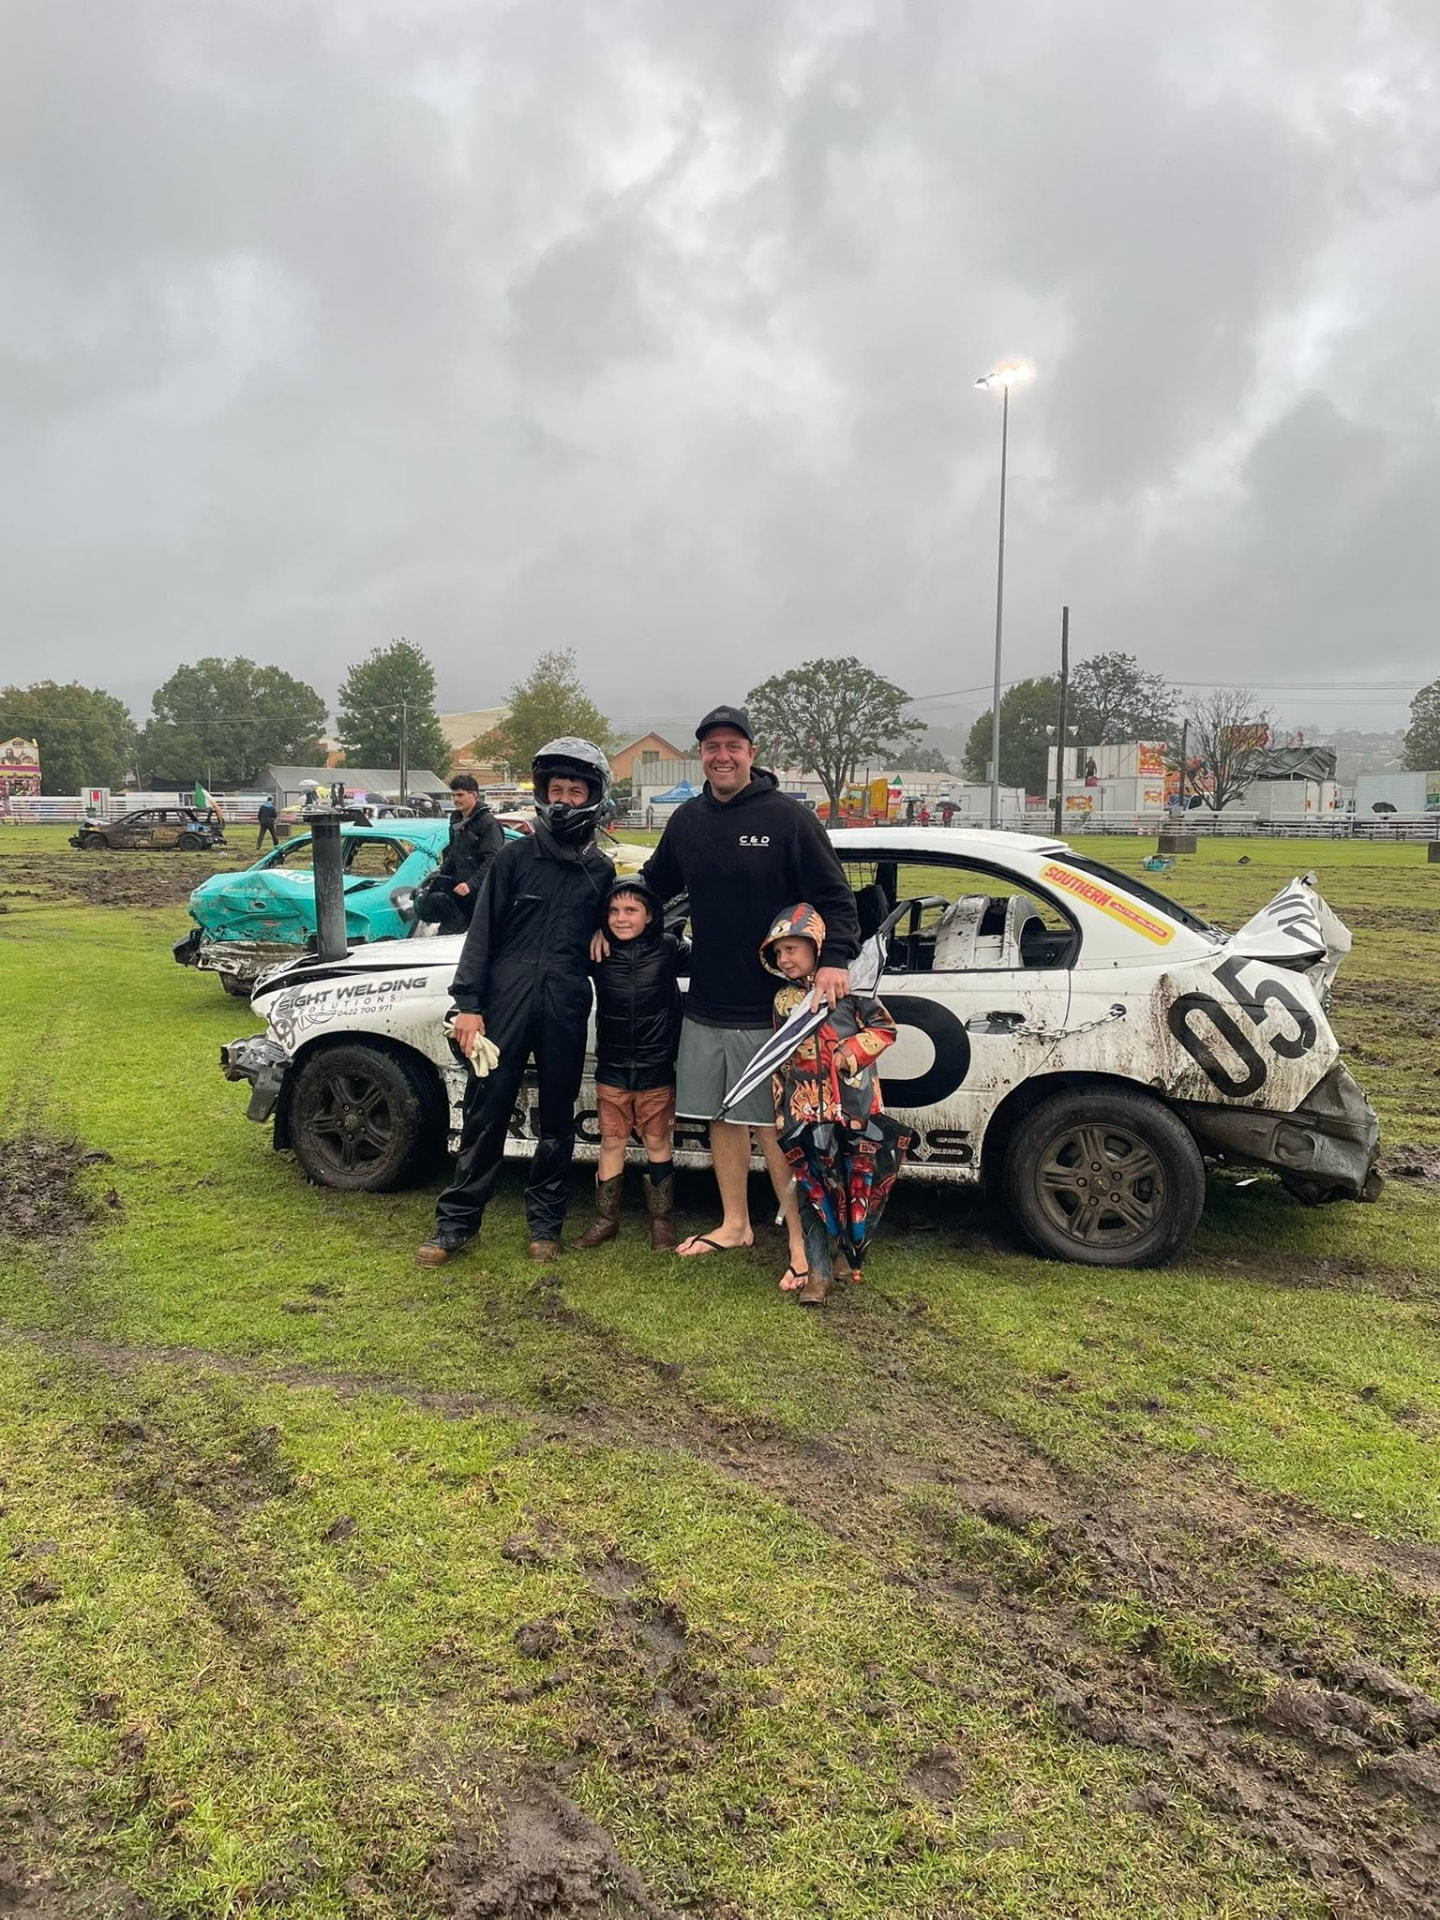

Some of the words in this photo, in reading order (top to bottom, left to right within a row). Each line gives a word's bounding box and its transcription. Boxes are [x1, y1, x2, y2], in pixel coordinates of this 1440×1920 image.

[739, 835, 748, 843] C
[760, 835, 770, 843] D
[1044, 866, 1112, 907] SOUTHERN
[278, 989, 334, 1012] SIGHT
[337, 976, 429, 1000] WELDING
[298, 993, 396, 1016] SOLUTIONS
[360, 1004, 377, 1014] 700
[378, 1004, 393, 1013] 971
[1168, 955, 1317, 1097] 05
